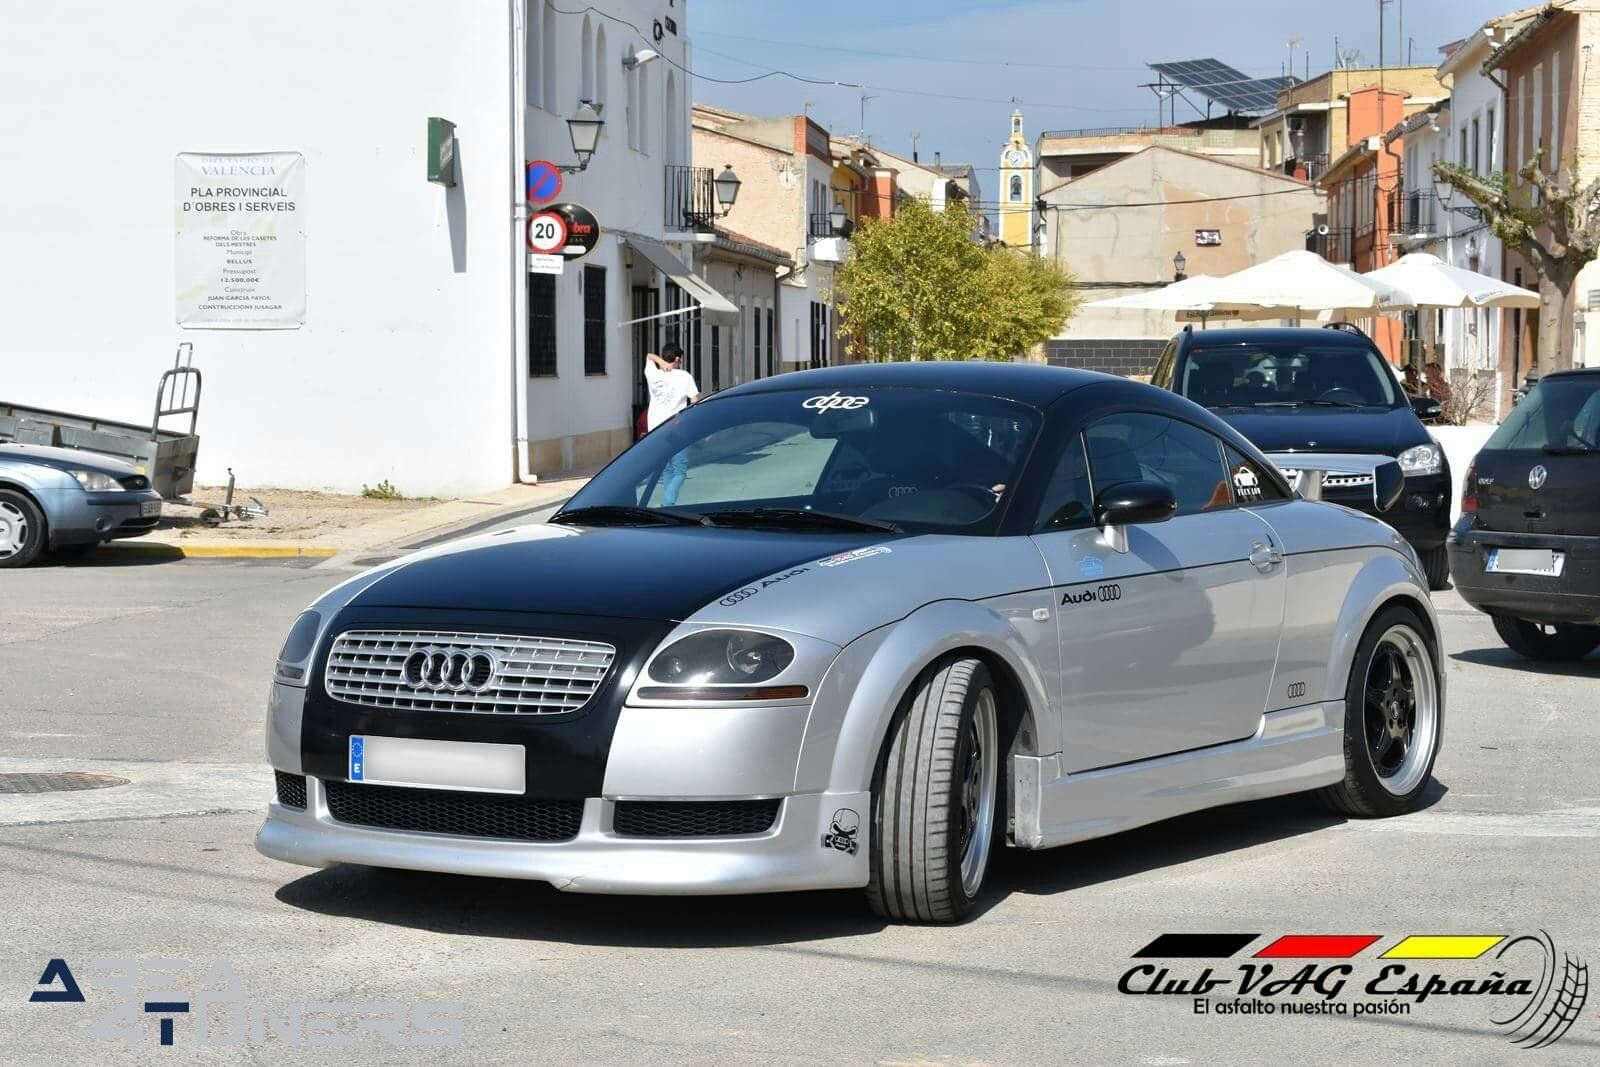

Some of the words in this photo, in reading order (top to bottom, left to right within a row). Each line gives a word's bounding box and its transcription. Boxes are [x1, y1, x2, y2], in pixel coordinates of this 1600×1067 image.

[191, 187, 213, 197] PLA
[216, 187, 288, 197] PROVINCIAL
[239, 202, 242, 212] I
[245, 202, 296, 212] SERVEIS
[534, 223, 555, 239] 20
[761, 567, 811, 588] Audi
[1061, 590, 1097, 605] Audi
